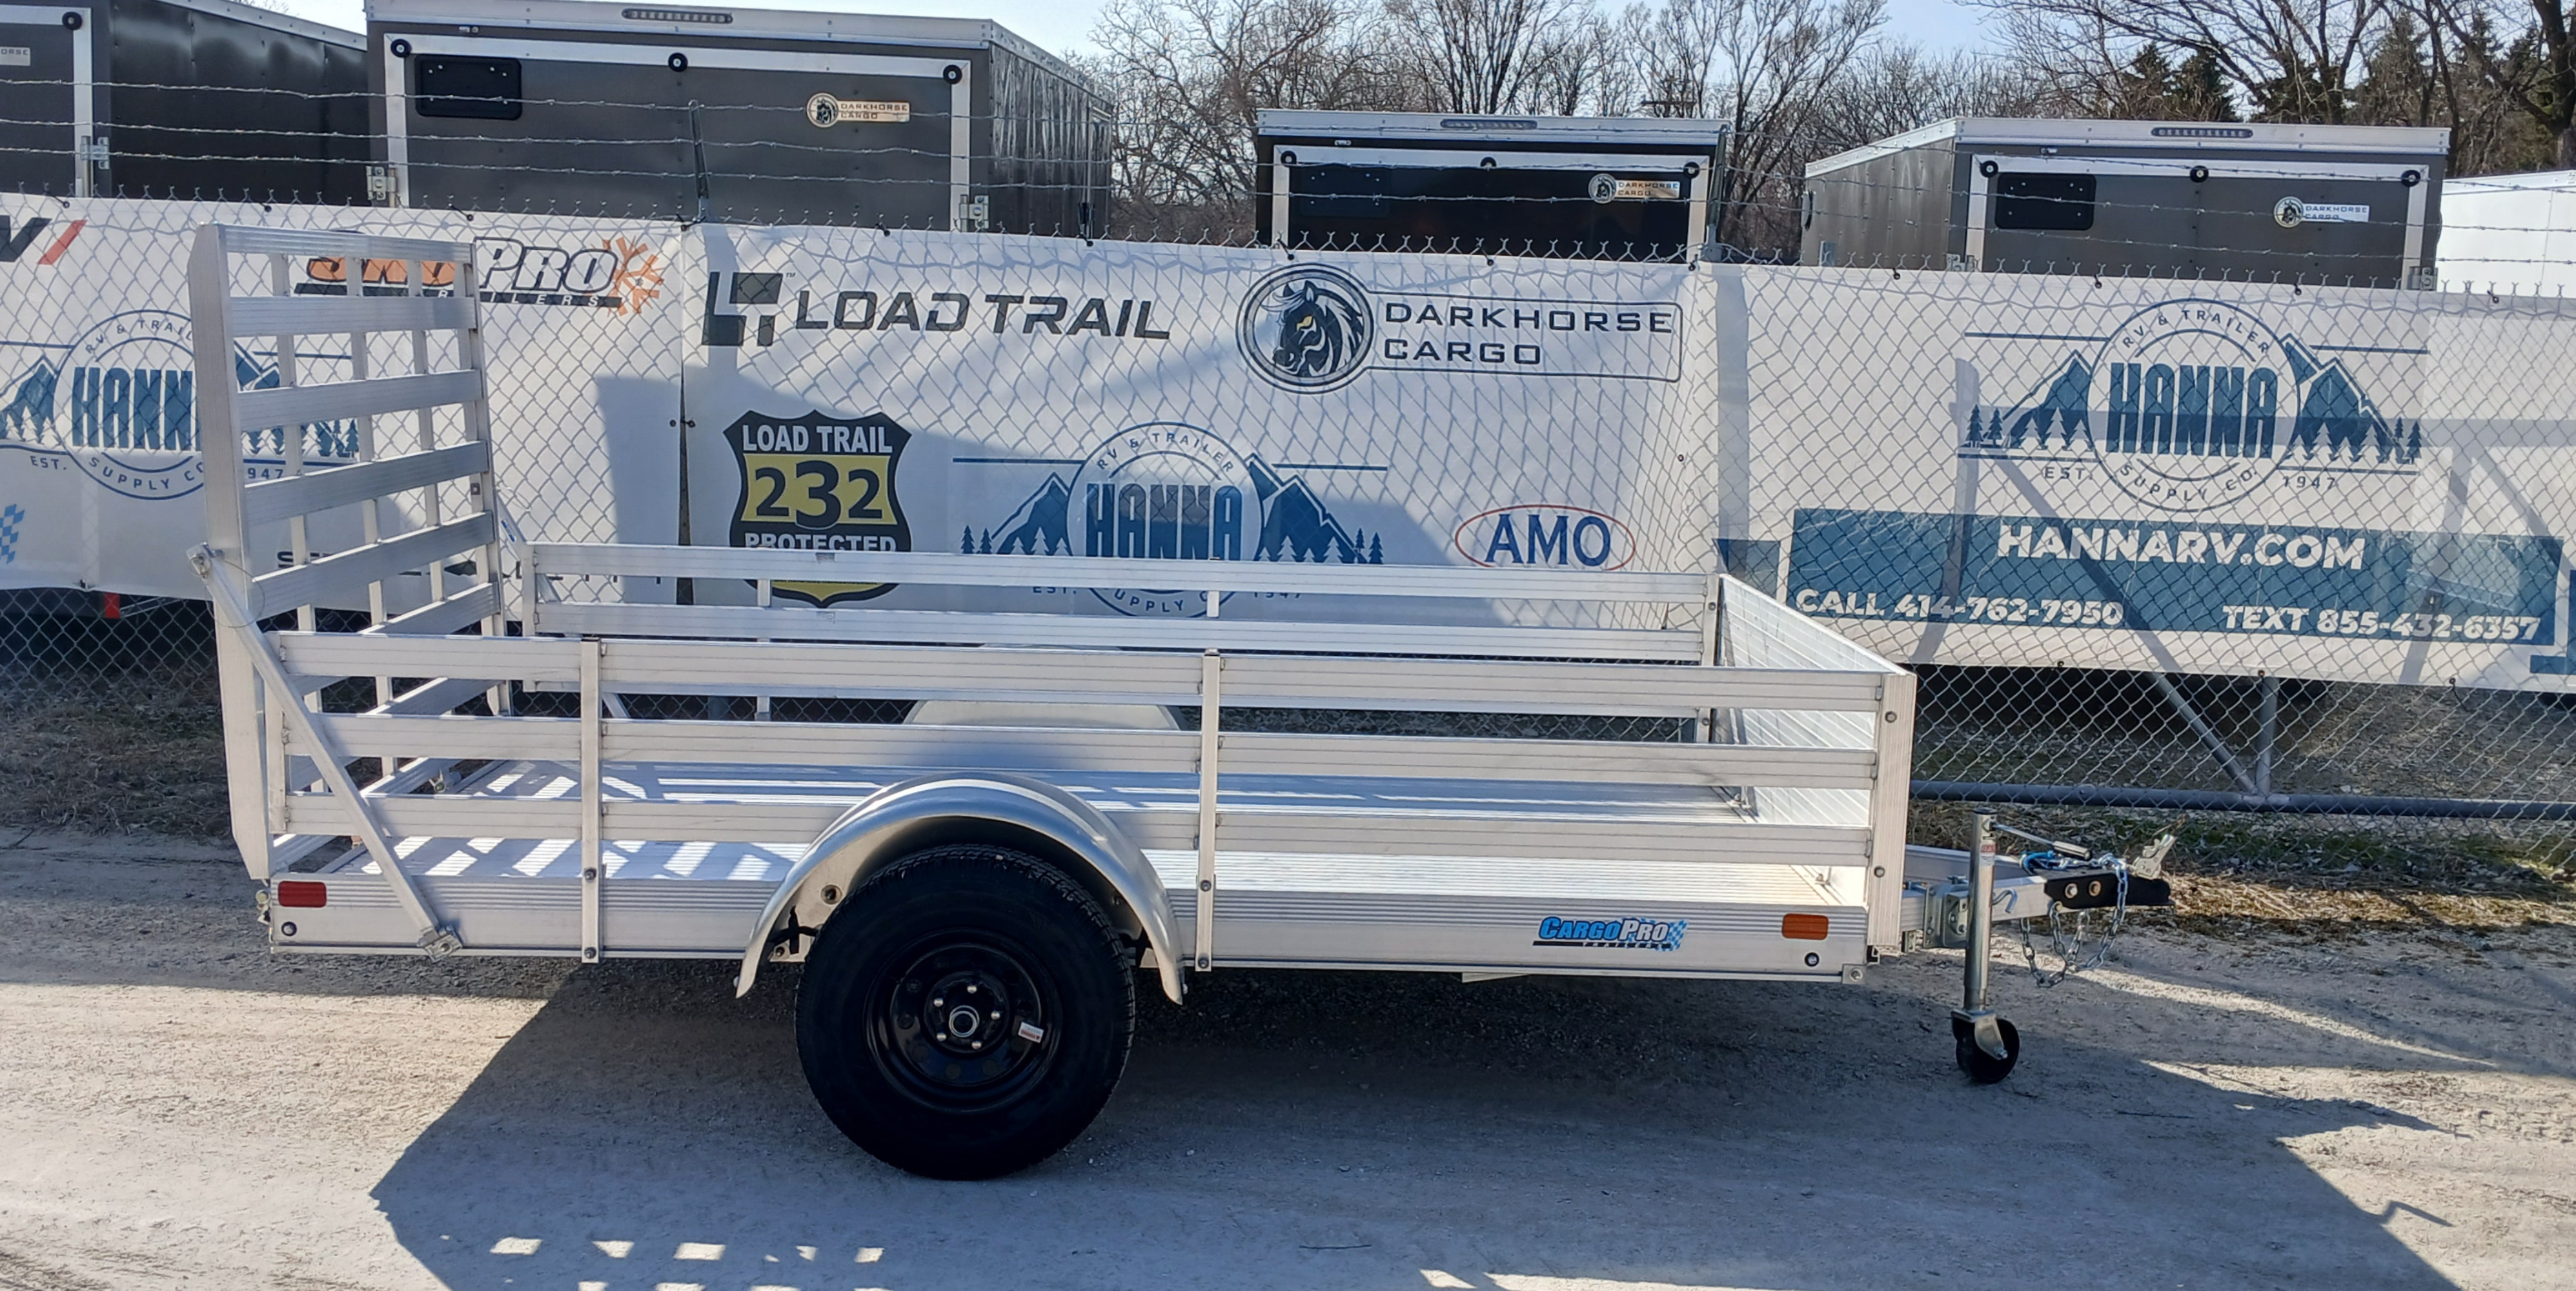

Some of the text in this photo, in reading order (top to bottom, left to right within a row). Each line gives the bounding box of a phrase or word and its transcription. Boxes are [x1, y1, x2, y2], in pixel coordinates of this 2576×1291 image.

[2306, 205, 2368, 213] DARKHORSE
[795, 290, 1170, 340] LOAD TRAIL
[1385, 302, 1672, 334] DARKHORSE
[2122, 325, 2145, 349] RV
[2181, 310, 2271, 354] TRAILER
[85, 334, 105, 354] RV
[138, 320, 192, 341] TRAIL
[1384, 338, 1541, 365] CARGO
[72, 366, 202, 452] HANN
[2105, 362, 2278, 459] HANNA
[742, 424, 893, 453] LOAD TRAIL
[1097, 448, 1118, 471] RV
[1151, 432, 1234, 472] TRAILER
[30, 455, 67, 470] EST.
[88, 456, 170, 491] SUPPLY
[247, 467, 284, 480] 947
[2044, 467, 2093, 482] EST.
[755, 460, 884, 530] 232
[2120, 464, 2207, 502] SUPPLY
[2282, 476, 2337, 491] 1947
[1086, 483, 1242, 561] HANNA
[1485, 513, 1612, 567] AMO
[1997, 525, 2366, 571] HANNARV.COM
[1113, 588, 1185, 613] UPPLY
[1796, 588, 2124, 627] CALL 414-762-7950
[2222, 605, 2541, 641] TEXT 855-432-6357
